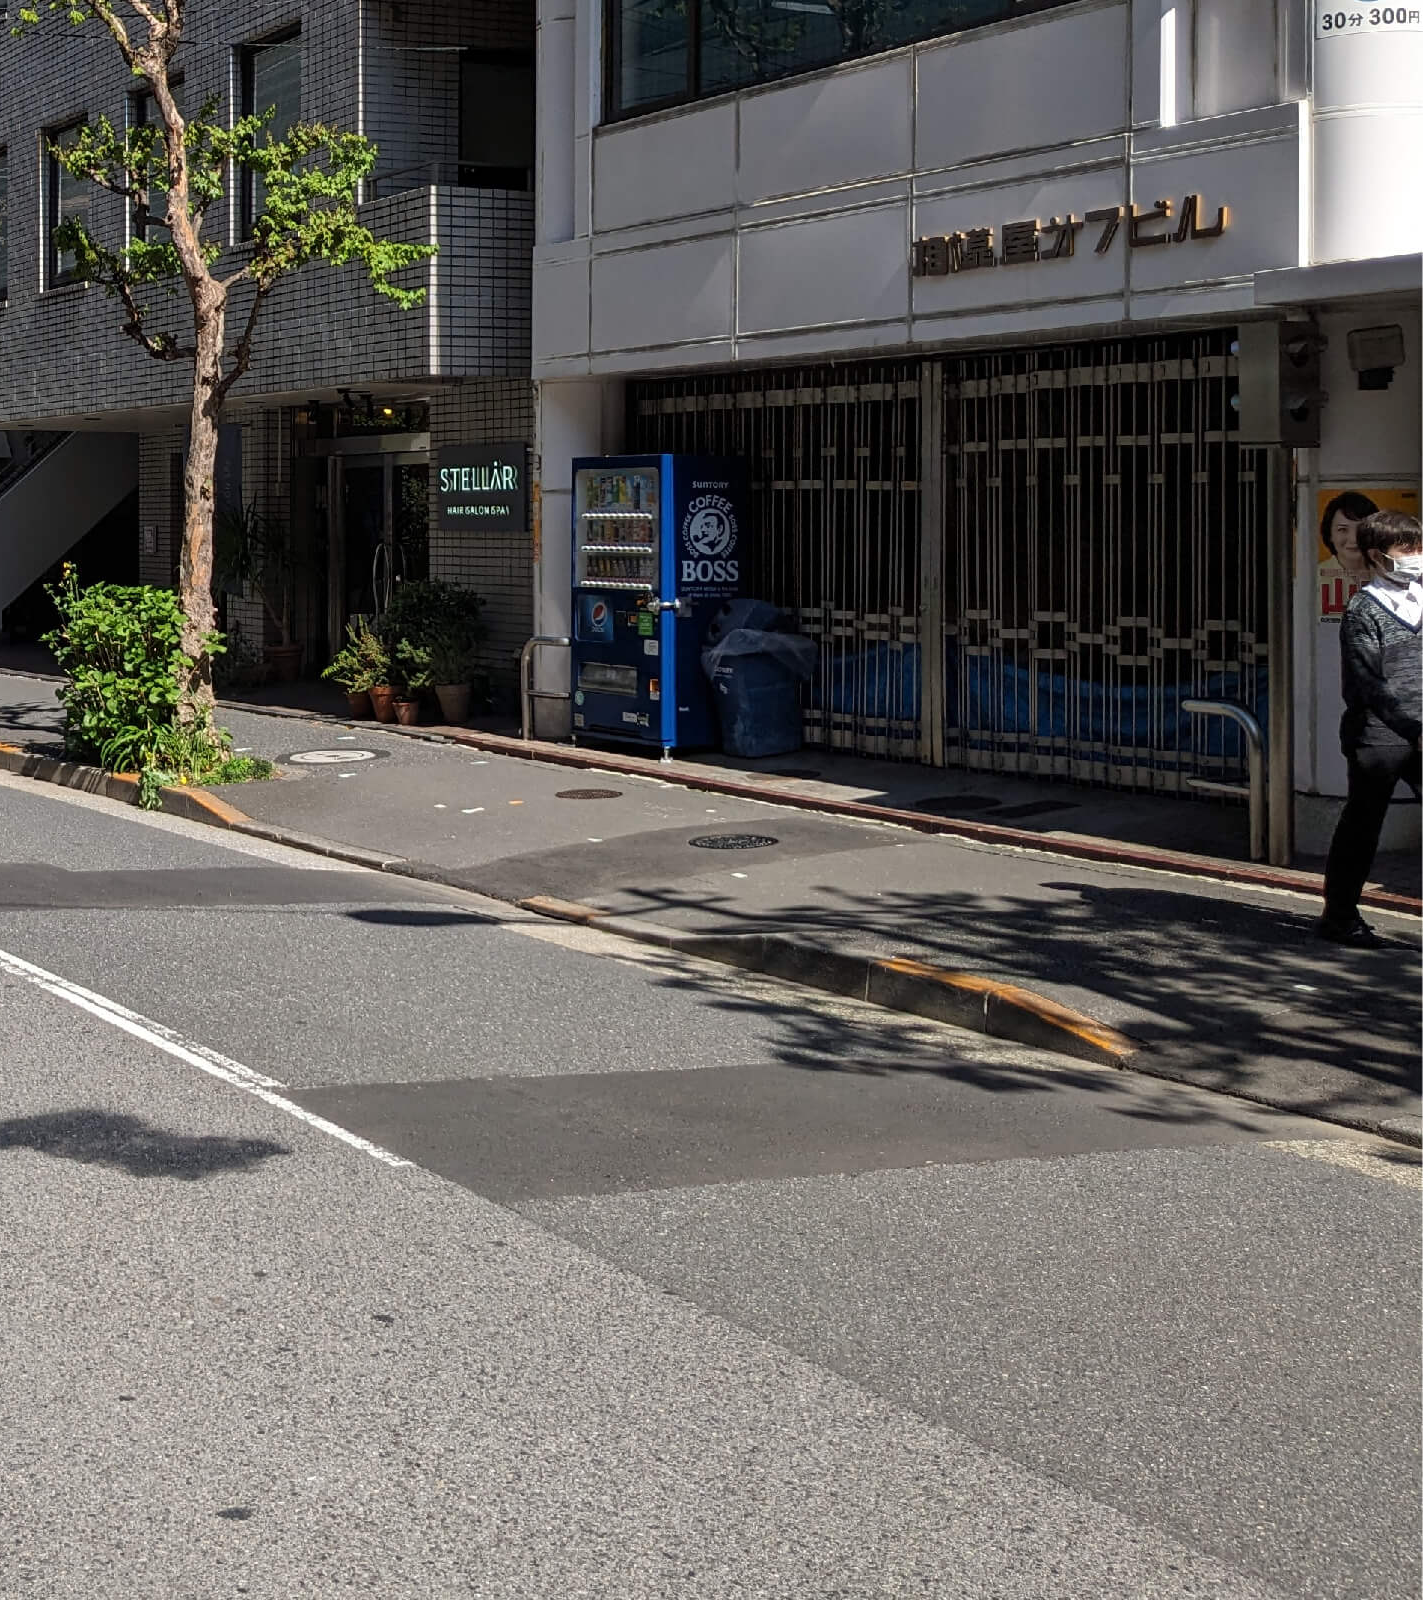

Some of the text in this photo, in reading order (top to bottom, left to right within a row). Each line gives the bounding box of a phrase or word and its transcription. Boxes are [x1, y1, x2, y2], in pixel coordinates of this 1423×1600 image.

[1322, 7, 1420, 31] 30分 300円
[688, 494, 733, 513] COFFEE
[681, 560, 738, 582] BOSS
